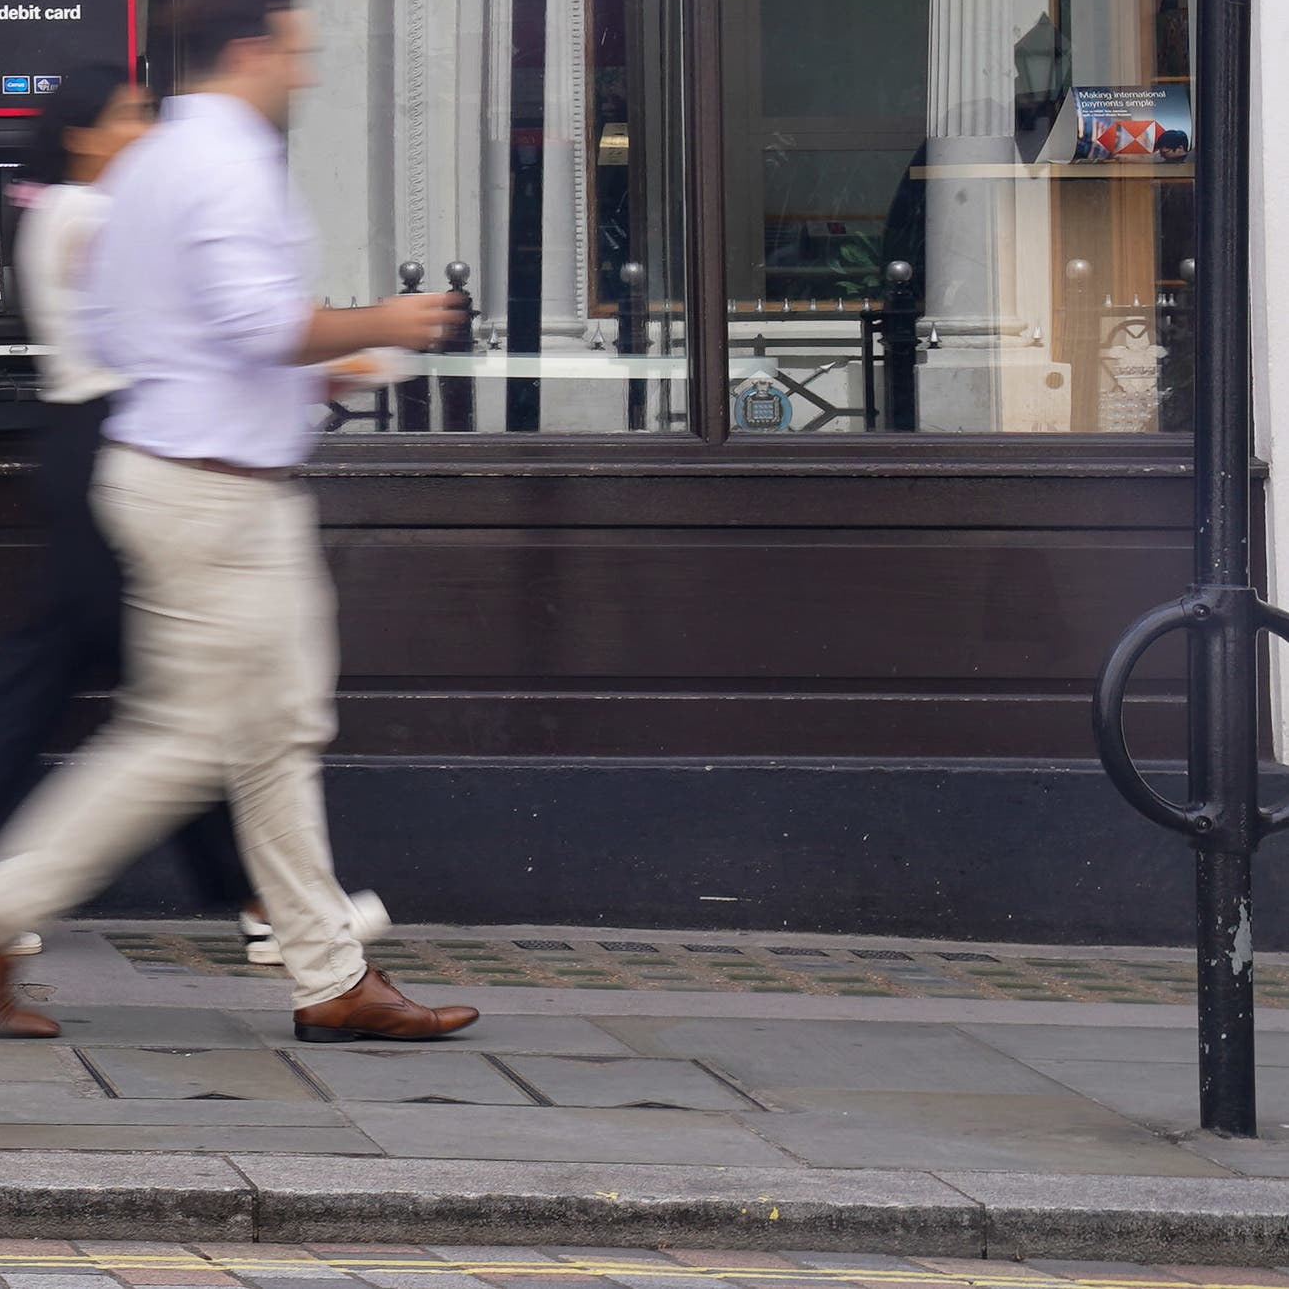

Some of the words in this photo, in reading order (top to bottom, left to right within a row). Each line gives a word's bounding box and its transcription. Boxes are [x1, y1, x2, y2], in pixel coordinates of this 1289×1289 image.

[44, 4, 81, 20] card
[1079, 91, 1112, 100] Making
[1082, 100, 1124, 108] payments
